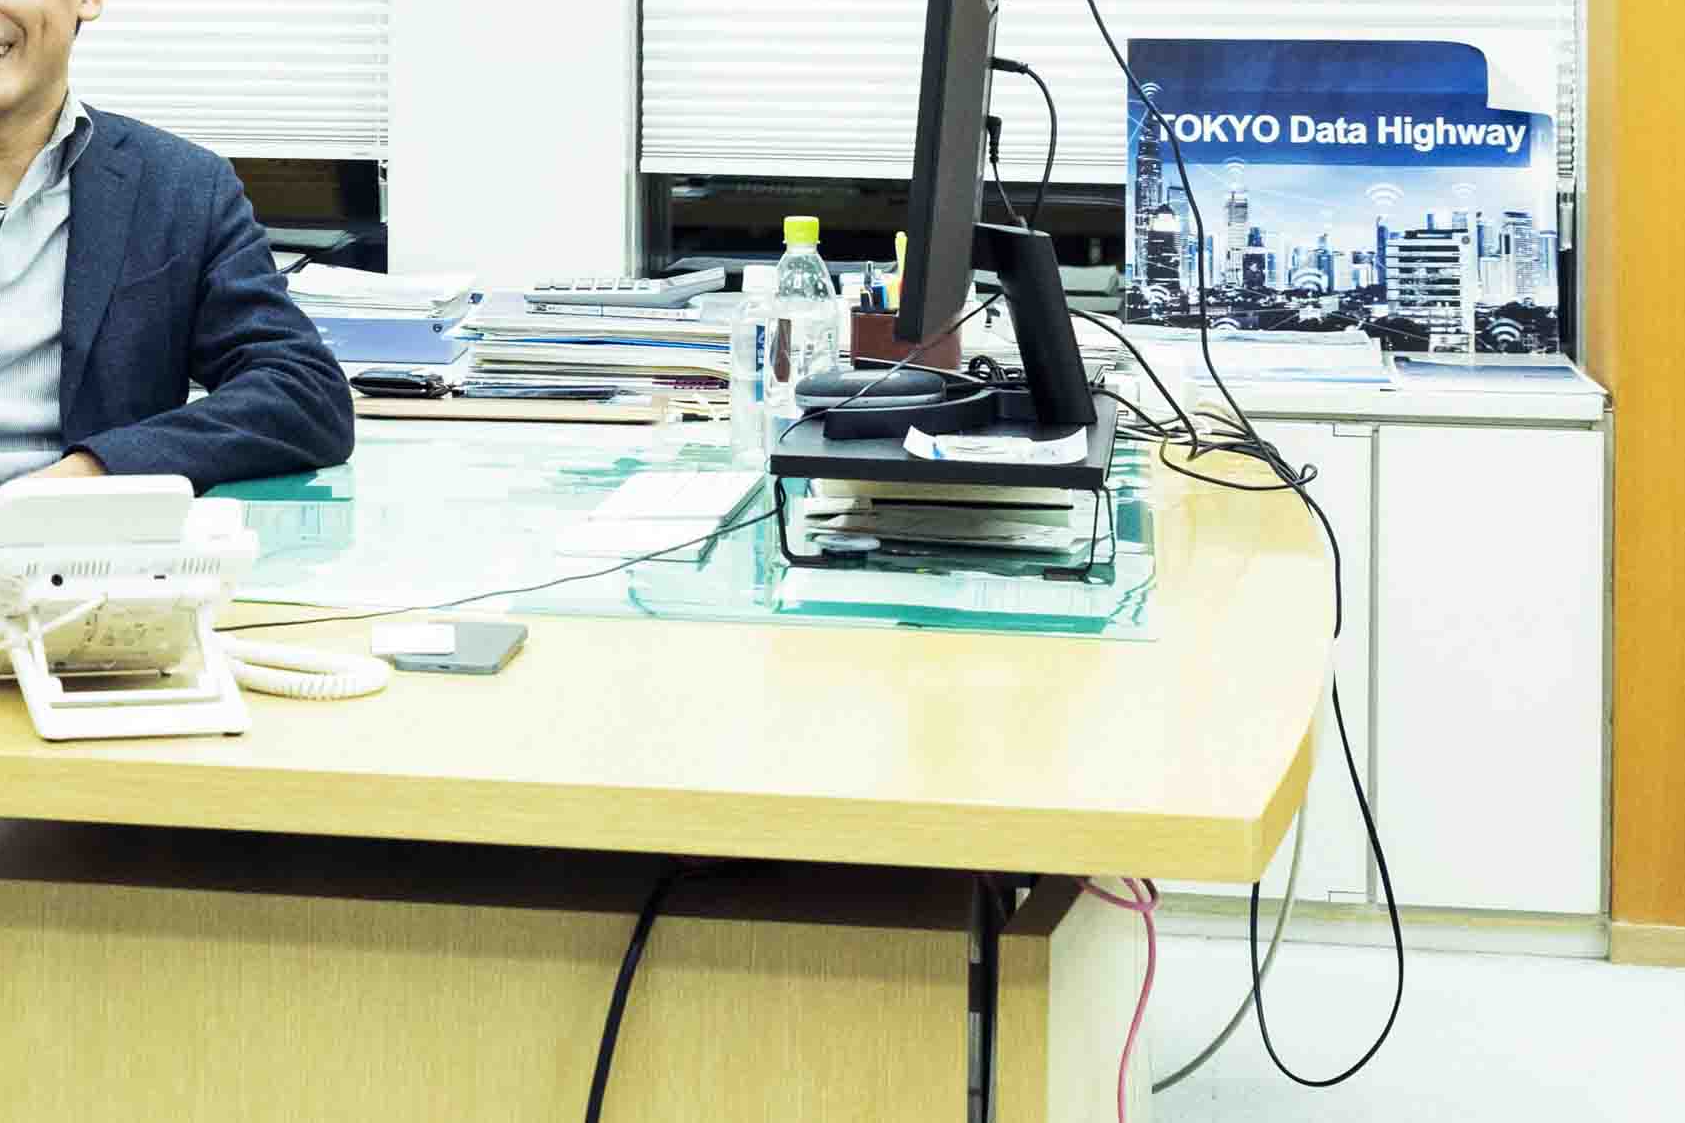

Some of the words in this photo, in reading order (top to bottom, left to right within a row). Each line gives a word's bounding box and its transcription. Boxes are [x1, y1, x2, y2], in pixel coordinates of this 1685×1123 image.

[1154, 112, 1281, 144] TOKYO
[1289, 115, 1368, 145] Data
[1377, 116, 1527, 152] Highway
